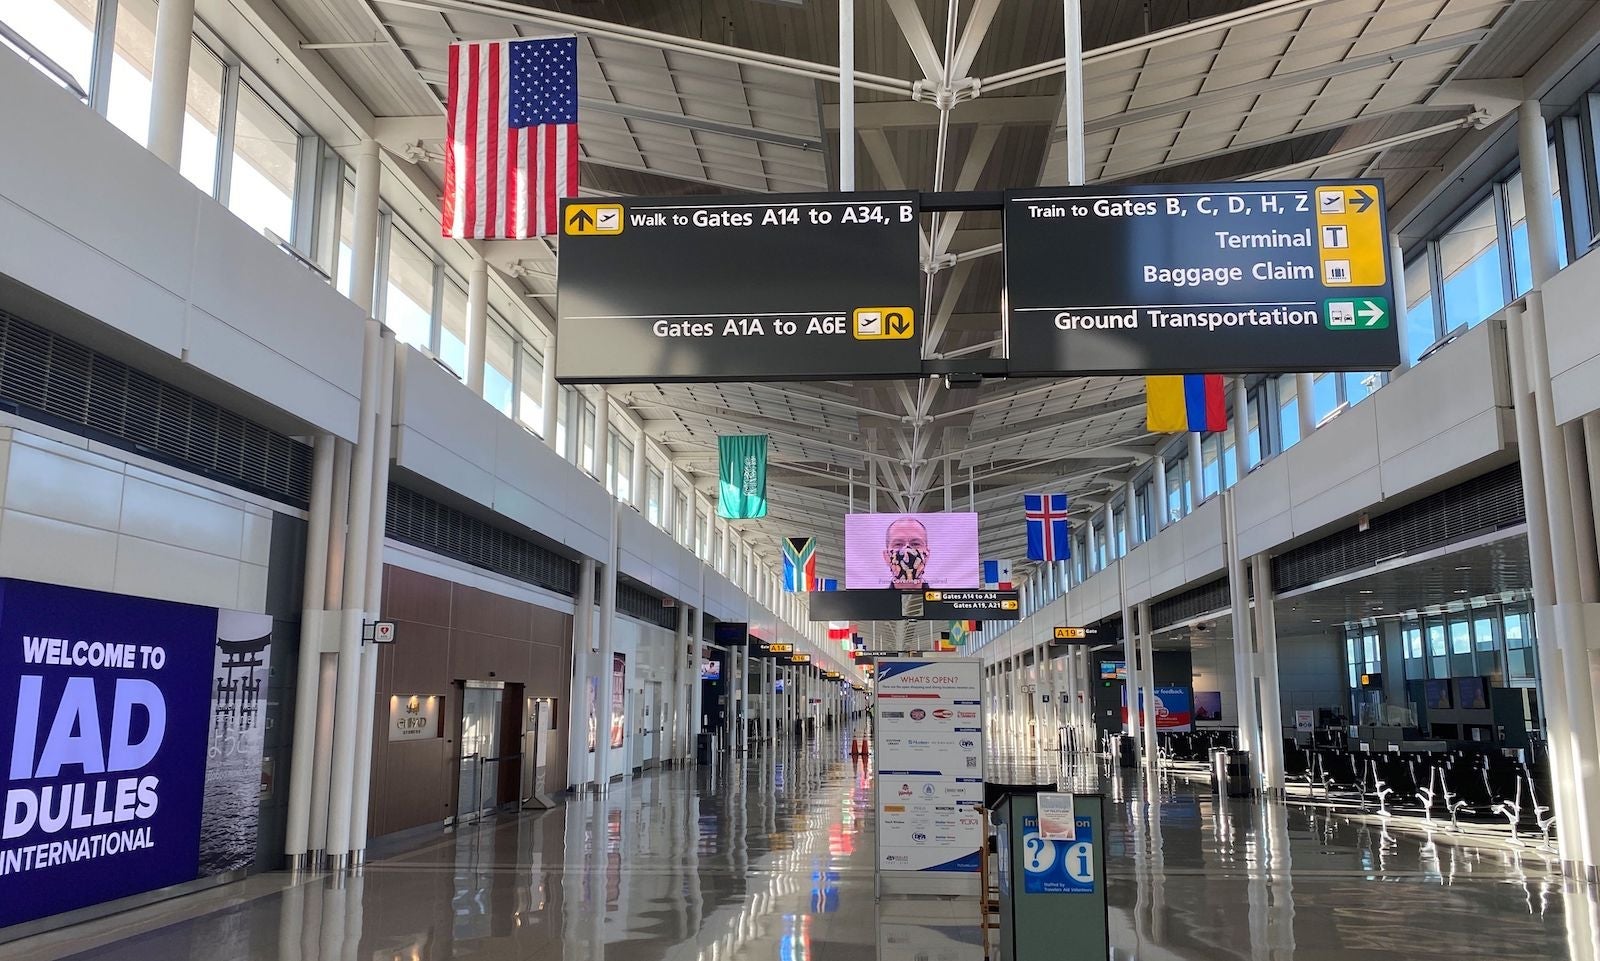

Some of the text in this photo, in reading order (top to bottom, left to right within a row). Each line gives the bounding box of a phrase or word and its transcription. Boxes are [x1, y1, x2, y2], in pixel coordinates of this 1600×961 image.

[630, 205, 914, 228] Walk to Gates A14 to A34, B
[1028, 195, 1310, 219] Train to Gates B, C, D, H, Z
[1215, 228, 1312, 249] Terminal
[1143, 261, 1315, 288] Baggage Claim
[652, 316, 847, 338] Gates A1A to A6E
[1054, 306, 1319, 332] Ground Transportation
[1057, 629, 1076, 637] A19
[23, 636, 166, 670] WELCOME TO
[900, 676, 959, 684] WHAT'S OPEN?
[9, 674, 167, 781] IAD
[3, 775, 160, 840] DULLES
[0, 826, 155, 876] INTERNATIONAL
